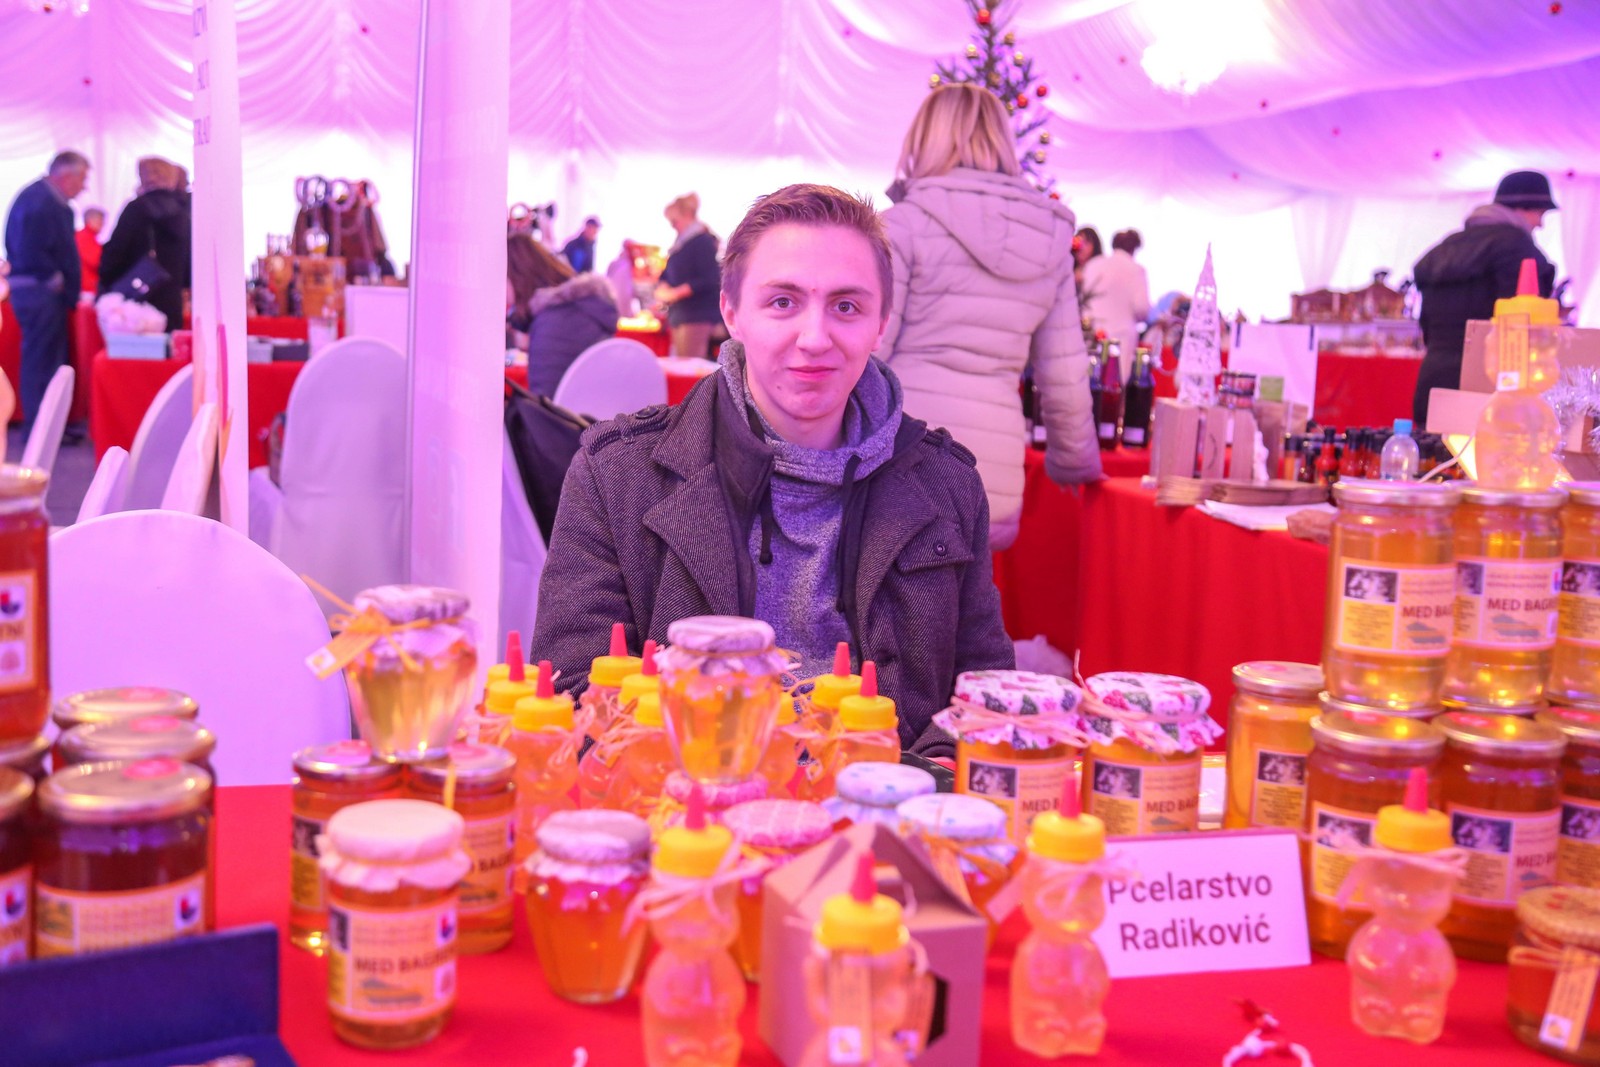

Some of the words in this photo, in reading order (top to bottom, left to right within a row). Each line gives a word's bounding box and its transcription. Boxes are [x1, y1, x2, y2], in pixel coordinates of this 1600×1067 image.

[1487, 597, 1521, 611] MED
[1402, 605, 1433, 618] MED
[1022, 799, 1051, 812] MED
[1145, 800, 1176, 813] MED
[1516, 853, 1545, 868] MED
[1119, 913, 1272, 951] Radiković
[354, 957, 395, 974] MED
